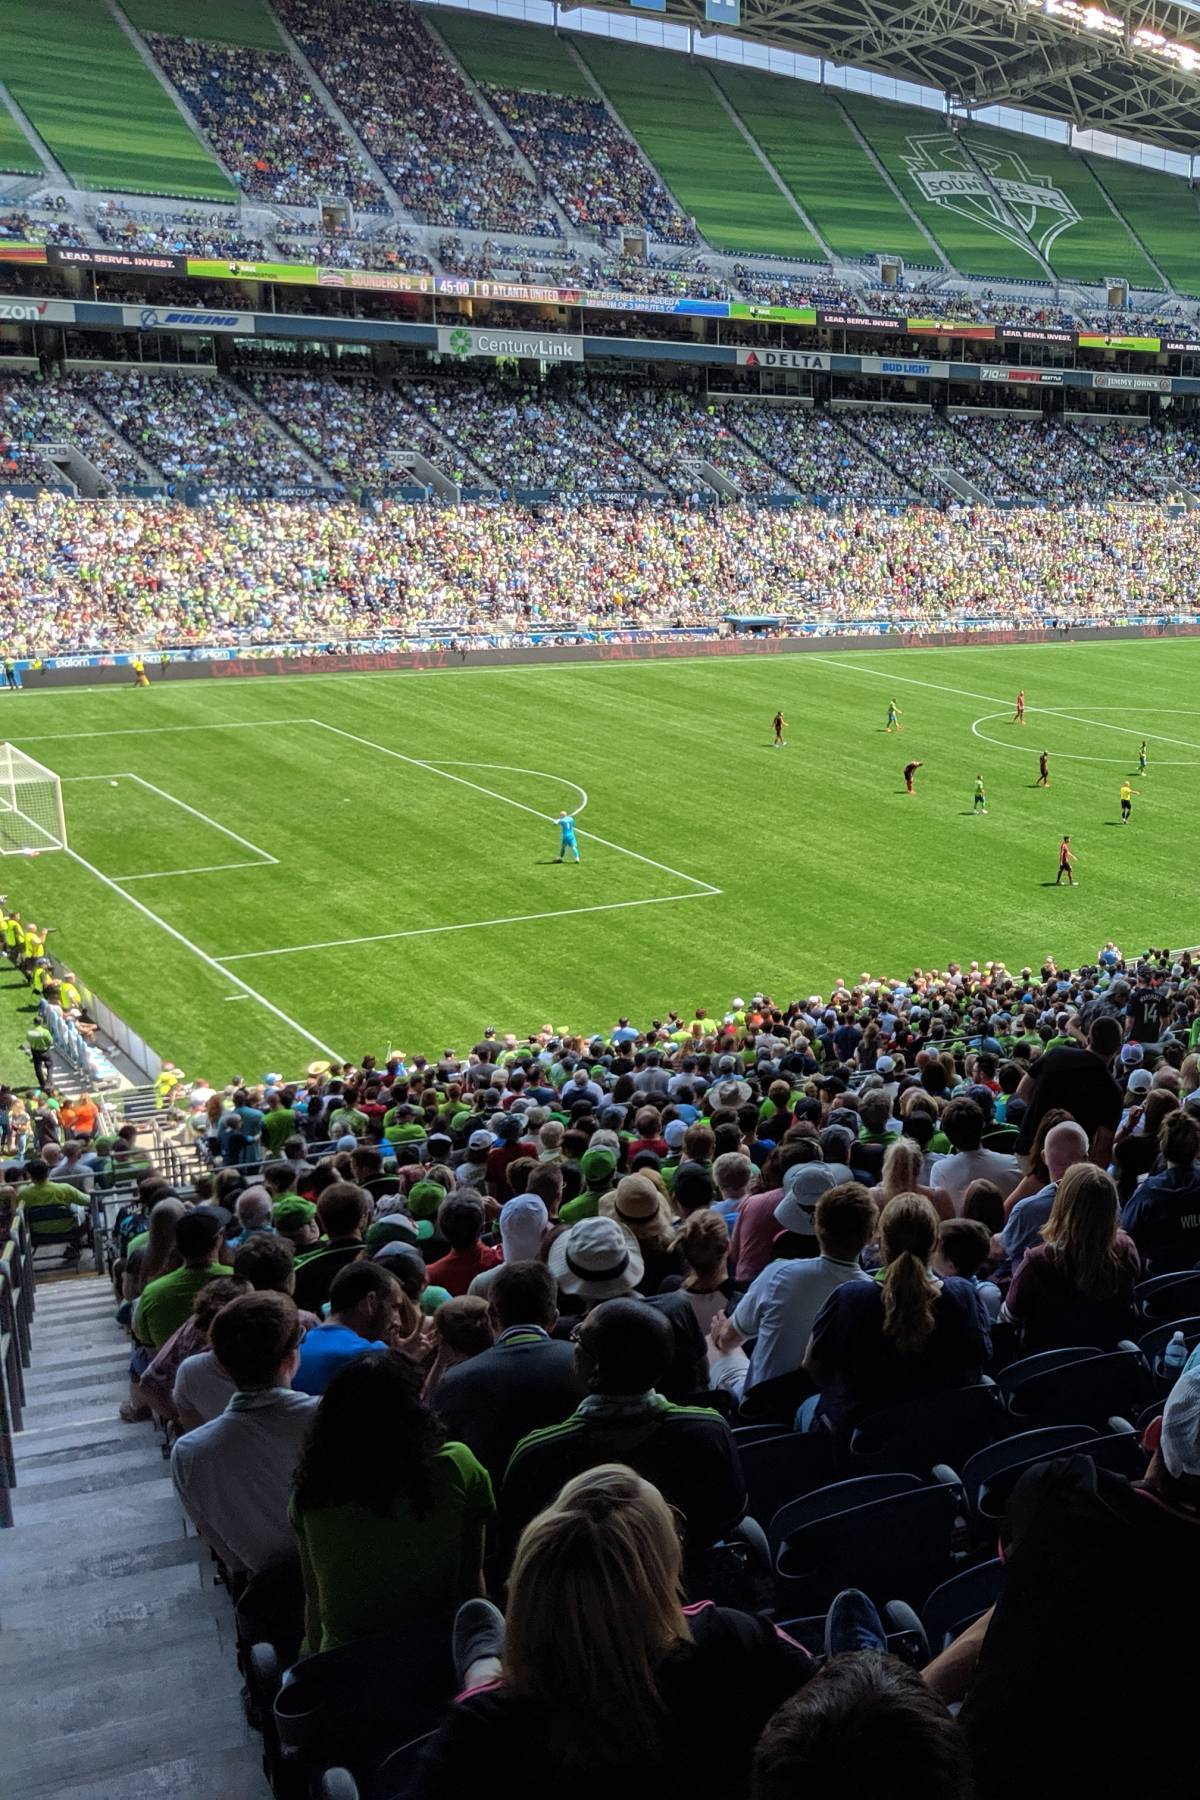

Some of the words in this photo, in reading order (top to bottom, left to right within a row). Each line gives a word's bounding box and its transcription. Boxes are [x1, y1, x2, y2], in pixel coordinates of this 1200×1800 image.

[1036, 193, 1067, 209] FC
[60, 252, 92, 262] LEAD.
[95, 254, 132, 266] SERVE.
[134, 257, 175, 269] INVEST.
[351, 275, 399, 289] SOUNDERS
[400, 278, 411, 290] FC
[420, 278, 427, 291] 0
[440, 280, 469, 295] 45:00
[482, 284, 488, 296] 0
[492, 284, 528, 299] ATLANTA
[529, 289, 559, 301] UNITED
[165, 313, 239, 327] BOEING
[825, 315, 844, 323] LEAD.
[846, 318, 871, 326] SERVE.
[873, 320, 899, 328] INVEST.
[1003, 330, 1022, 338] LEAD.
[1023, 331, 1046, 340] SERVE.
[1047, 333, 1071, 341] INVEST.
[478, 336, 573, 357] CenturyLink
[765, 353, 823, 369] DELTA
[881, 362, 902, 373] BUD
[903, 363, 931, 374] LIGHT
[982, 369, 999, 379] 710
[1108, 378, 1133, 386] JIMMY
[1134, 380, 1158, 388] JOHN'S
[56, 657, 90, 668] slalom
[211, 660, 266, 677] CALL
[1143, 1003, 1157, 1024] 14
